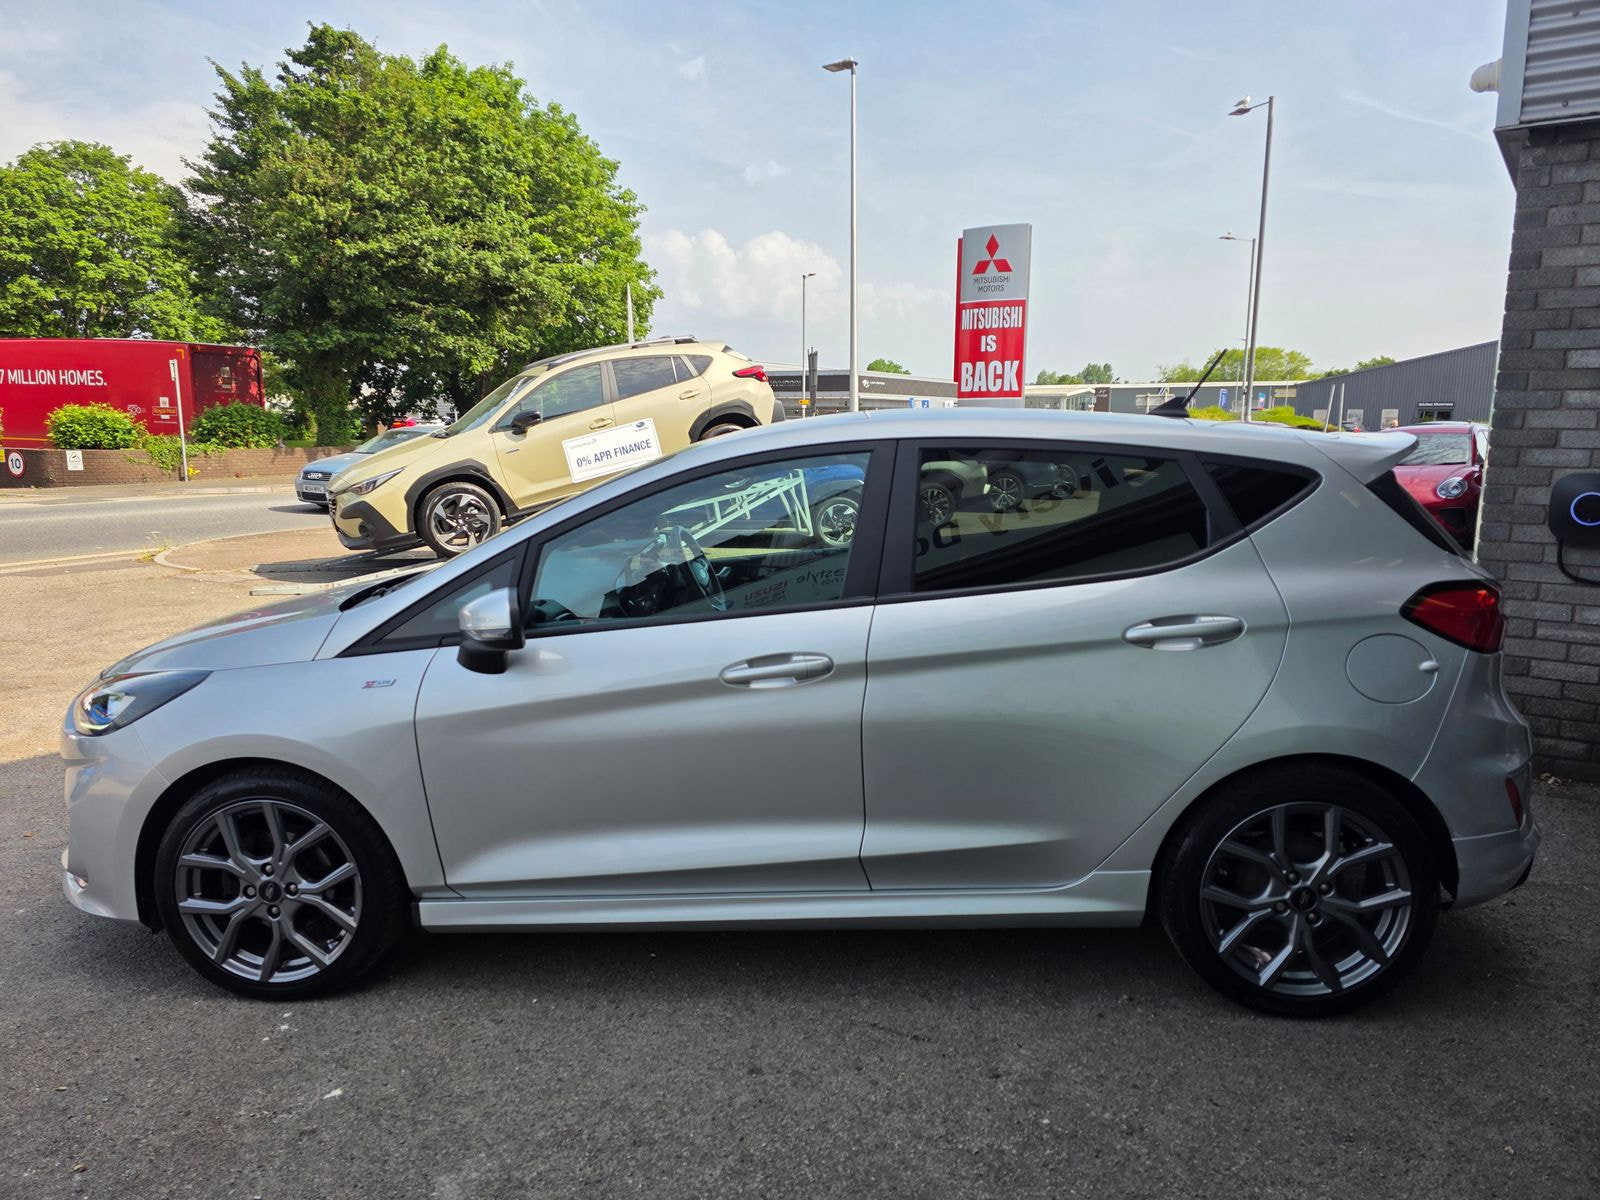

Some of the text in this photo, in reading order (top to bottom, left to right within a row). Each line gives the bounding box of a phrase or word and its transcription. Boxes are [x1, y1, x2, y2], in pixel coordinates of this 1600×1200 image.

[973, 275, 1011, 284] MITSUBISHI
[977, 284, 1005, 293] MOTORS
[961, 306, 1023, 330] MITSUBISHI
[980, 335, 997, 352] IS
[7, 369, 56, 385] MILLION
[59, 369, 107, 386] HOMES.
[961, 360, 1019, 392] BACK
[576, 455, 591, 467] 0%
[594, 449, 613, 463] APR
[614, 439, 652, 457] FINANCE
[10, 457, 21, 469] 10
